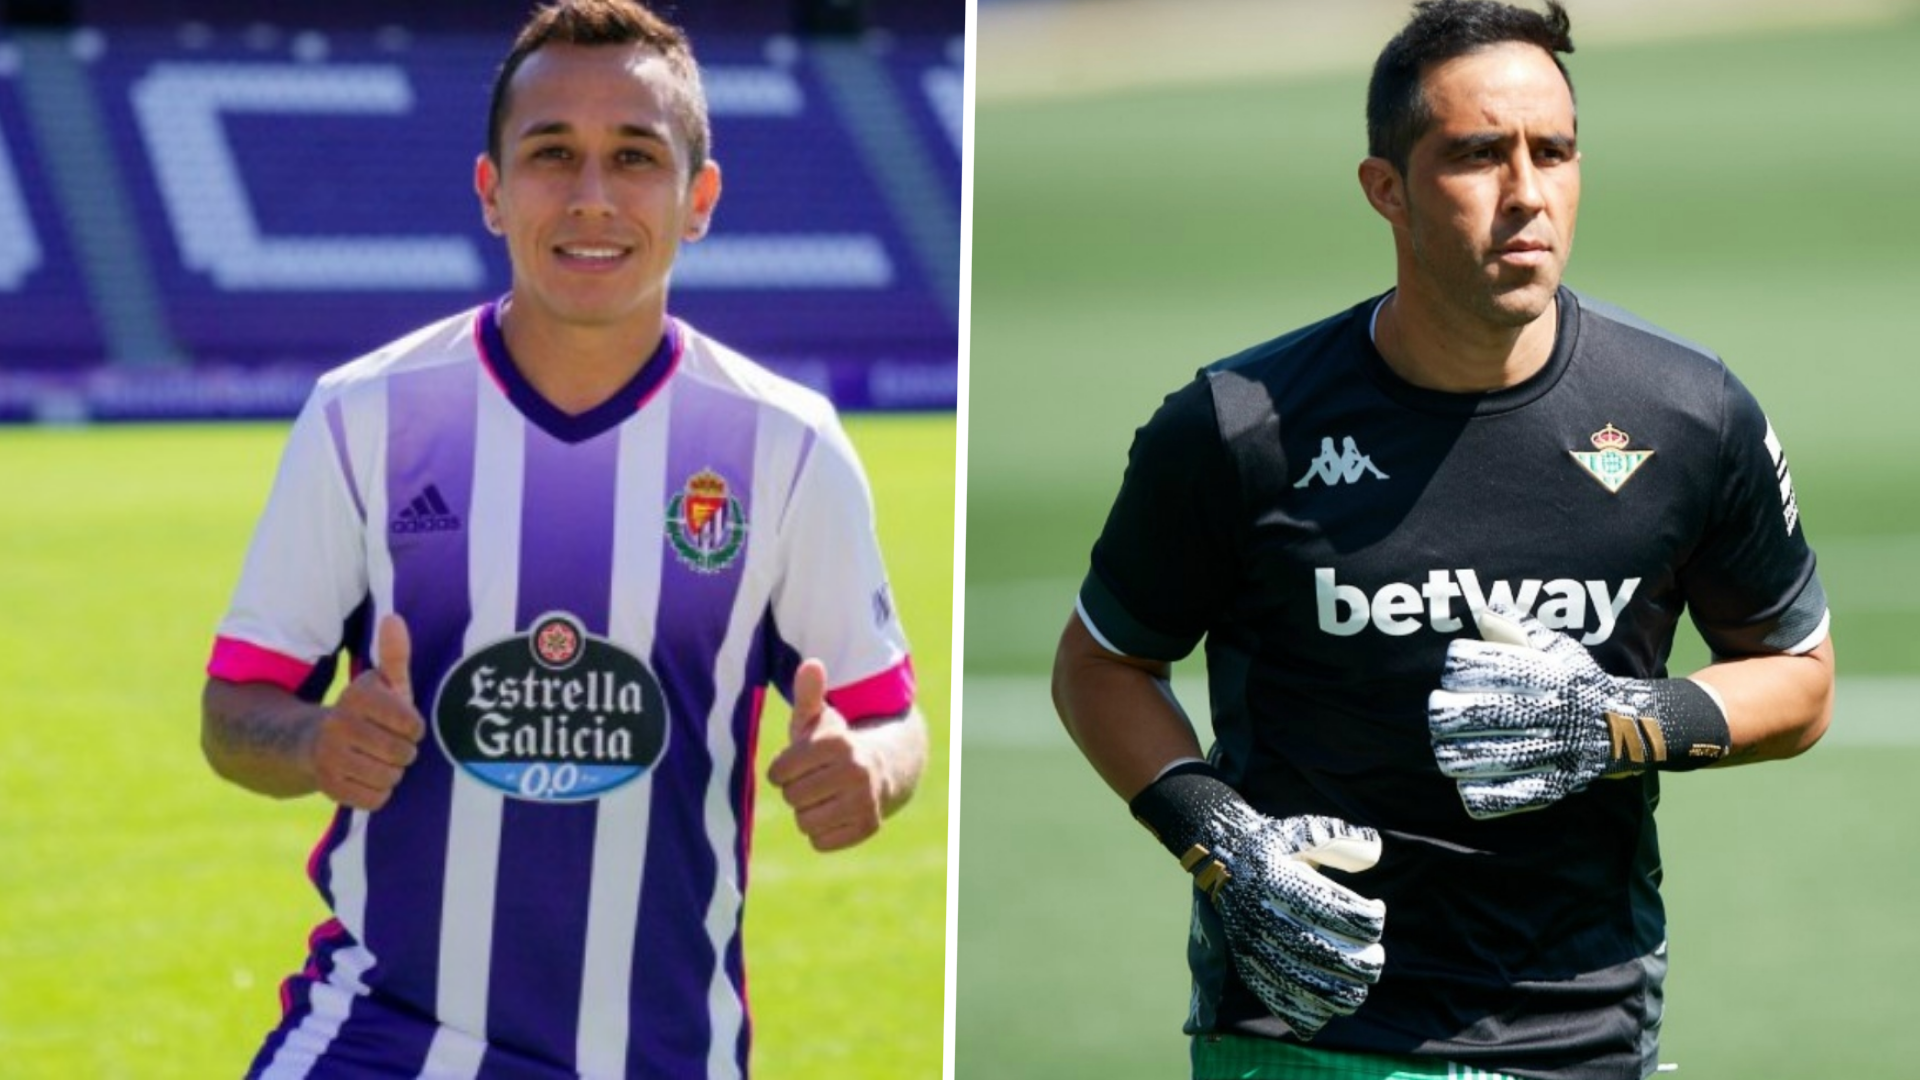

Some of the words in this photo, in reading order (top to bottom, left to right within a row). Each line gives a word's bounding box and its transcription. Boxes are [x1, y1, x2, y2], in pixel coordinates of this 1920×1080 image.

[392, 515, 461, 534] adidas
[1314, 567, 1642, 646] betway
[468, 664, 643, 714] Estrella
[474, 712, 632, 761] Galicia
